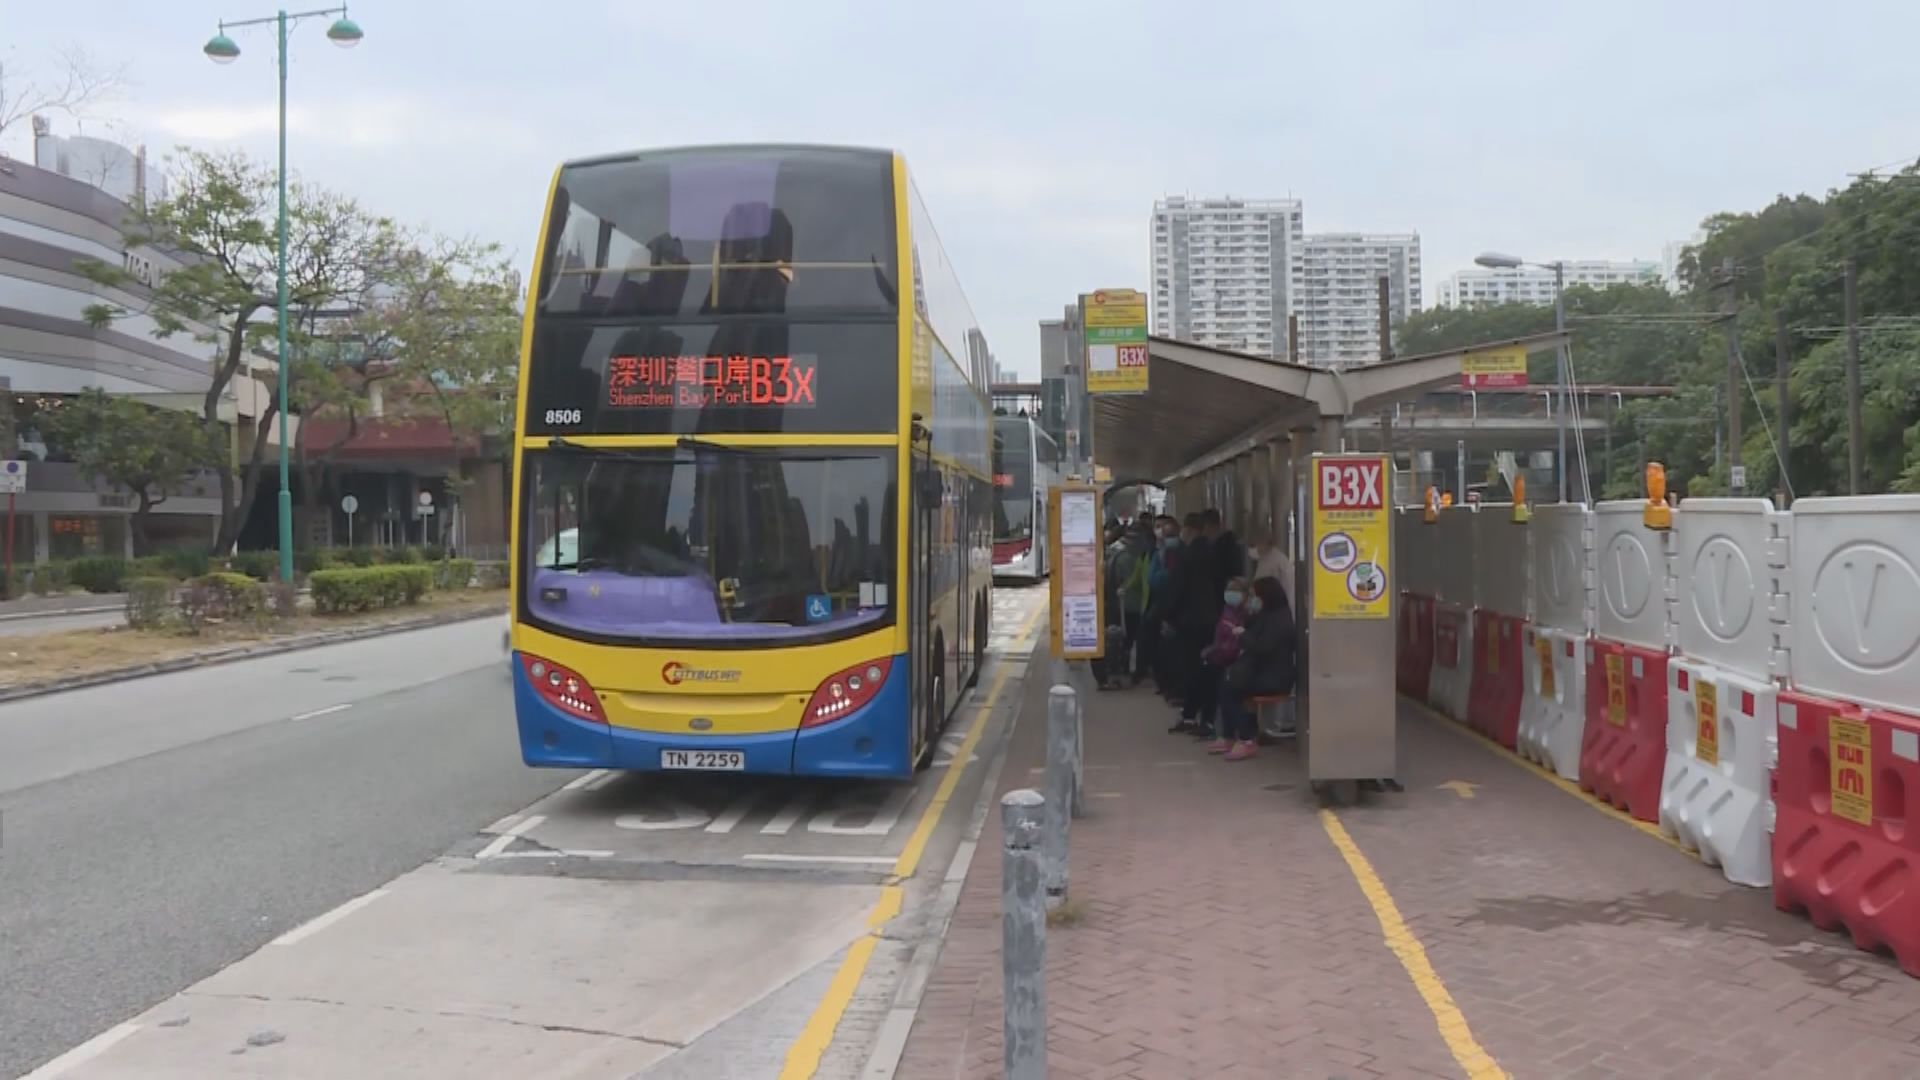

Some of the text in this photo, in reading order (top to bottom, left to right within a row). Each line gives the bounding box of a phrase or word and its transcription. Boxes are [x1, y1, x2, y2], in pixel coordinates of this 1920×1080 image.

[1119, 347, 1146, 366] B3X
[609, 355, 750, 387] 深圳灣口岸
[609, 385, 750, 408] Shenzhen Bay Port
[545, 409, 581, 424] 8506
[1322, 465, 1381, 506] B3X
[665, 752, 740, 768] TN 2259
